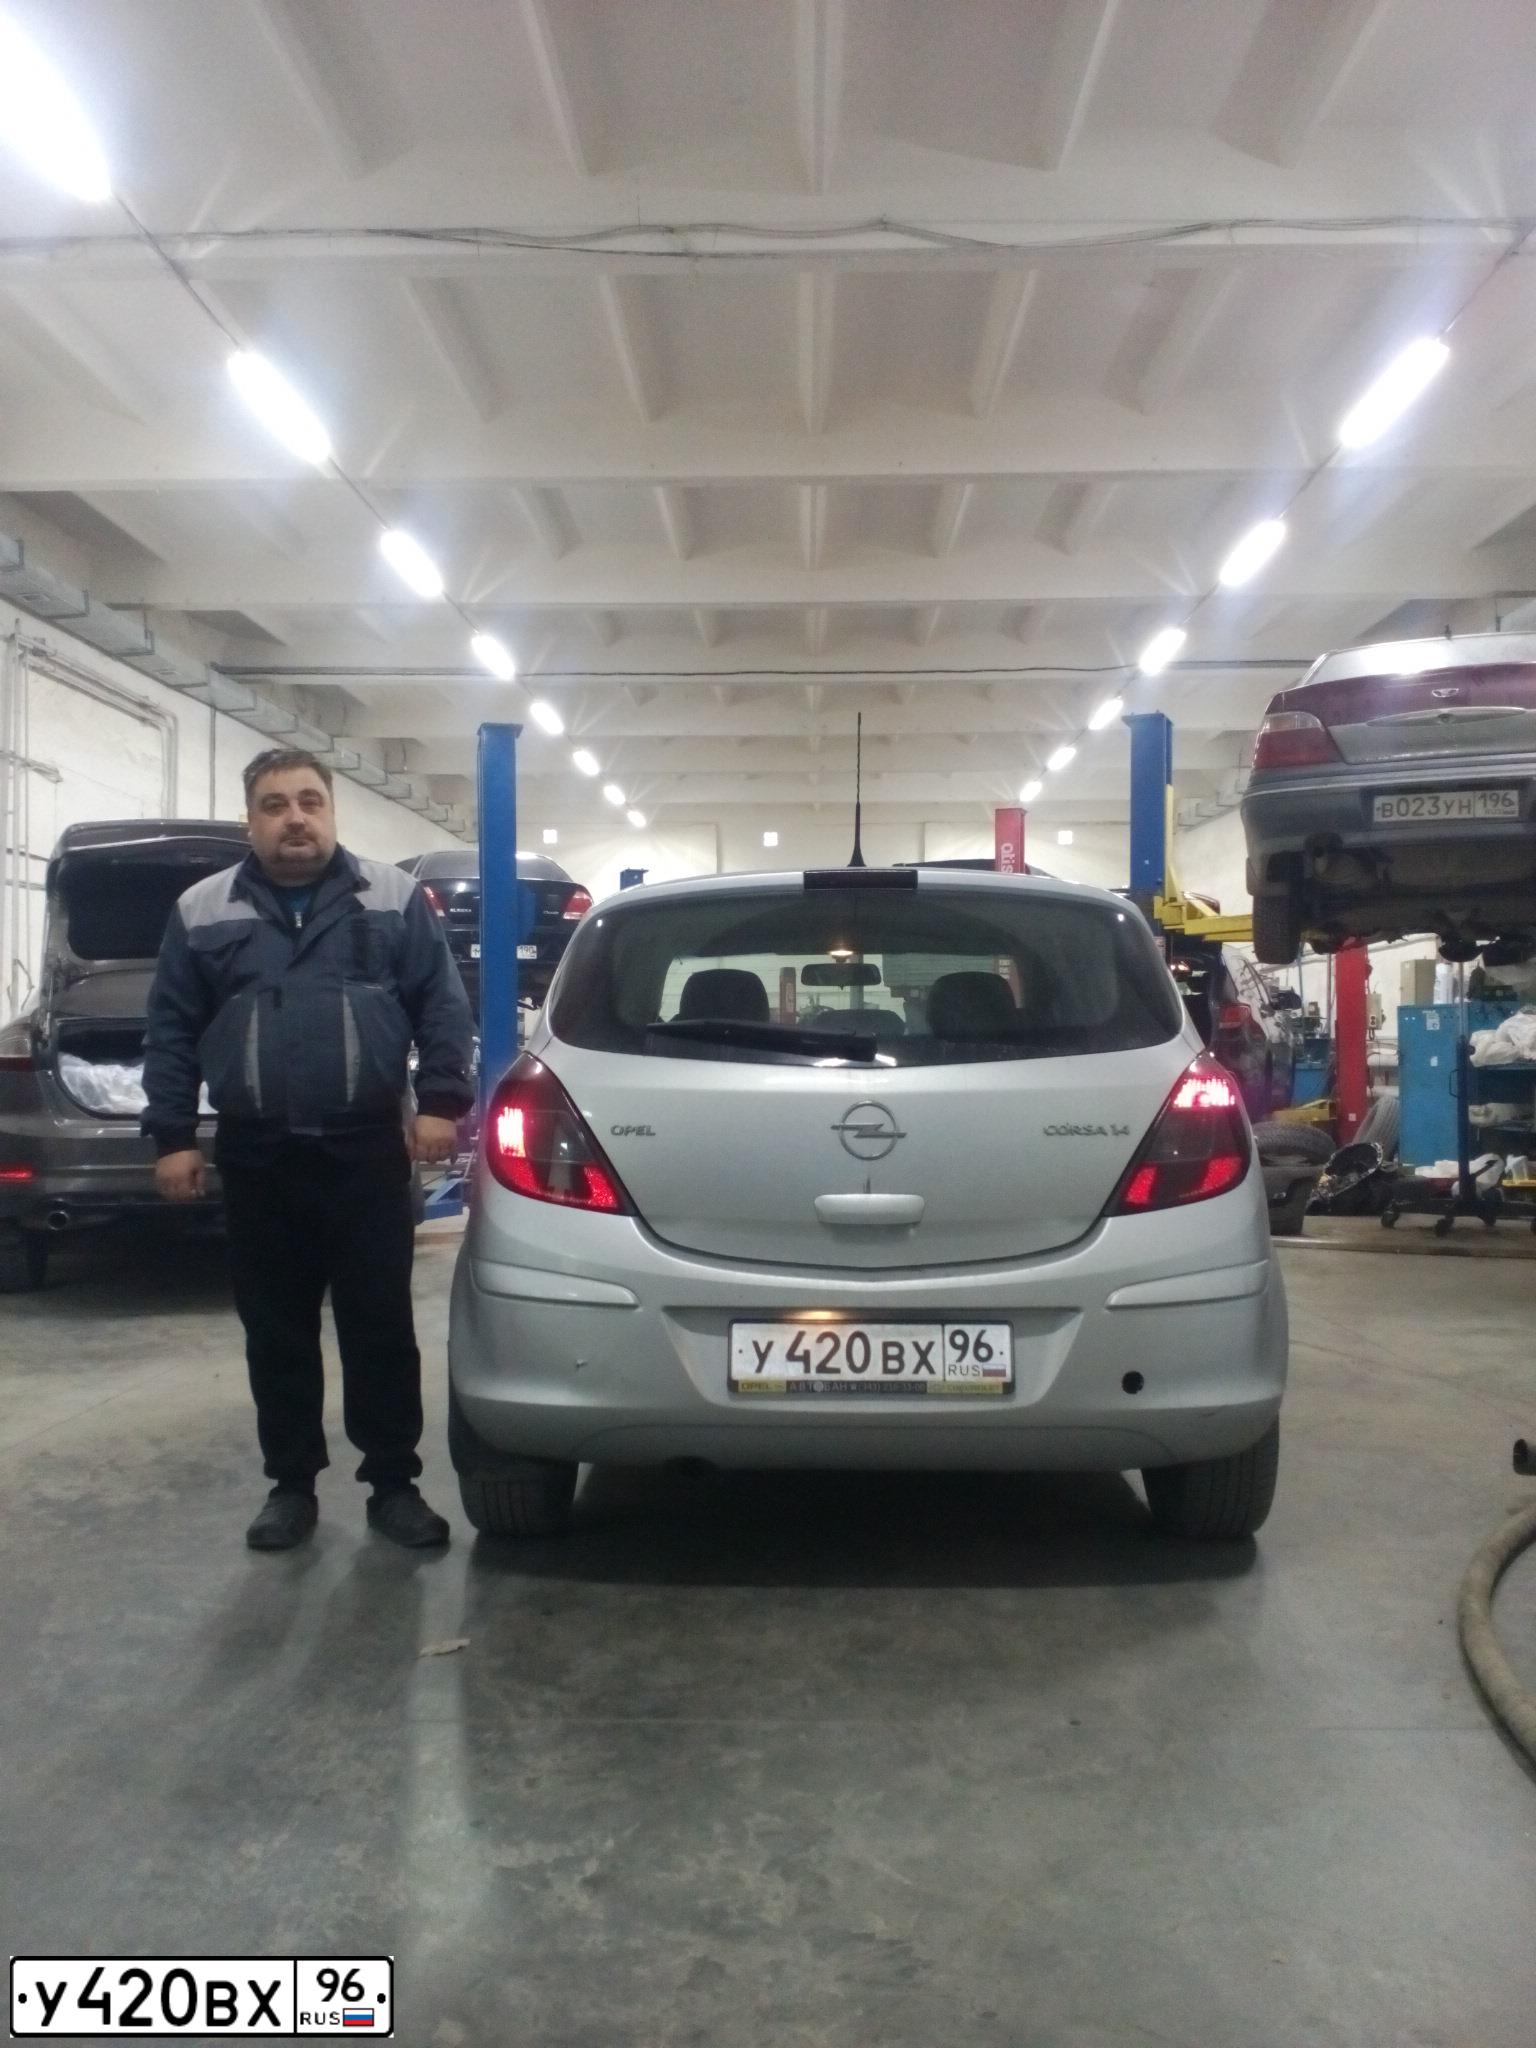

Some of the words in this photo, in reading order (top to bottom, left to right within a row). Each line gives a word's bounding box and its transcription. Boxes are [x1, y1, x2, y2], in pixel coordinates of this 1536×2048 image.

[1381, 796, 1472, 818] В023УН
[1478, 792, 1515, 808] 196
[610, 1125, 656, 1136] OPEL
[1043, 1124, 1108, 1136] CORSA
[752, 1330, 937, 1375] У420ВХ
[949, 1329, 994, 1363] 96
[948, 1365, 980, 1376] RUS
